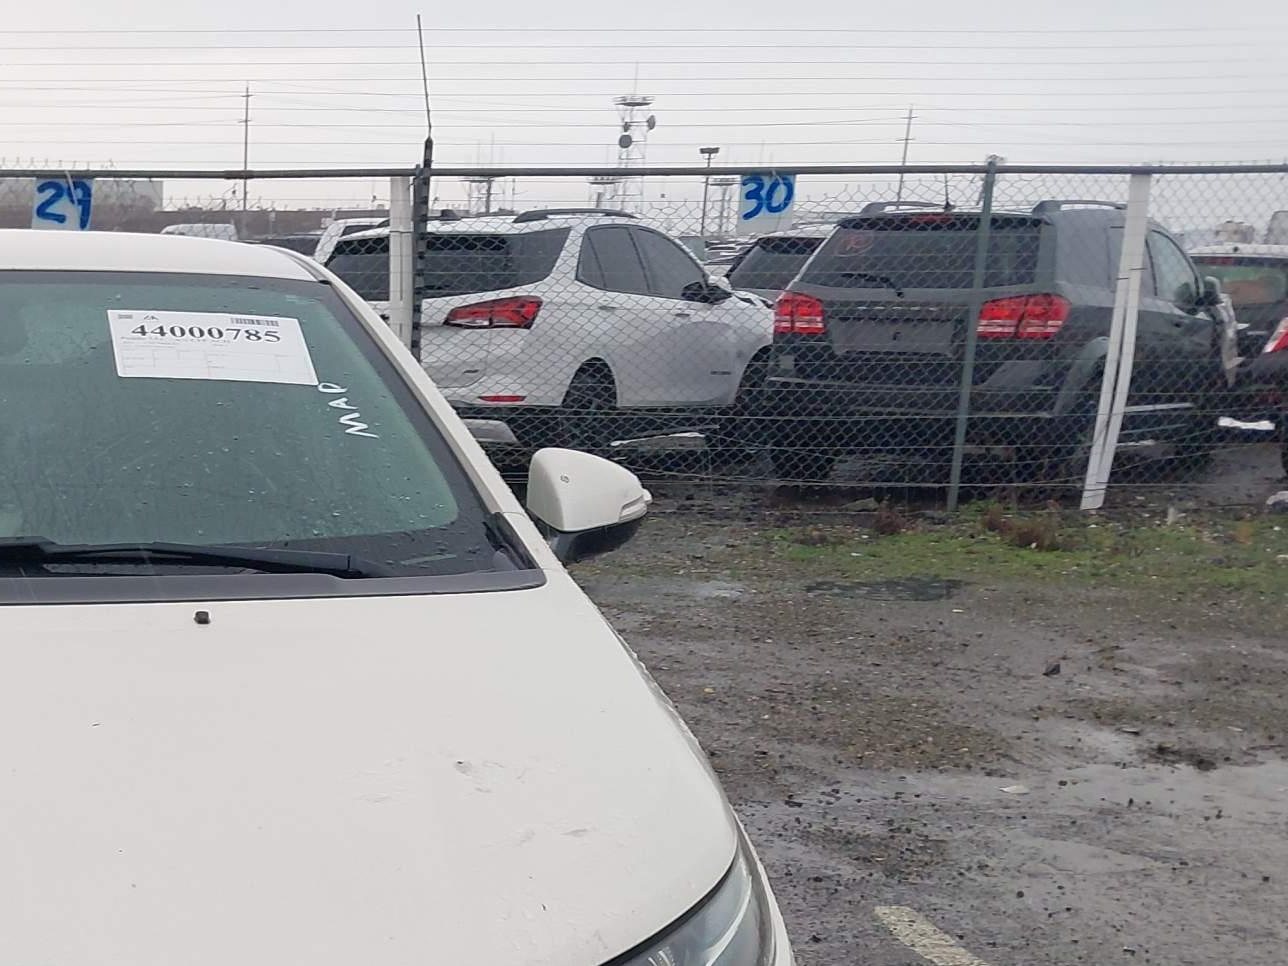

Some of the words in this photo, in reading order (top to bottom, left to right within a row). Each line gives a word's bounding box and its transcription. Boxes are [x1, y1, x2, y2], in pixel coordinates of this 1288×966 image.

[36, 180, 91, 230] 29
[742, 175, 793, 220] 30
[131, 324, 281, 344] 44000785
[318, 382, 380, 439] MAP
